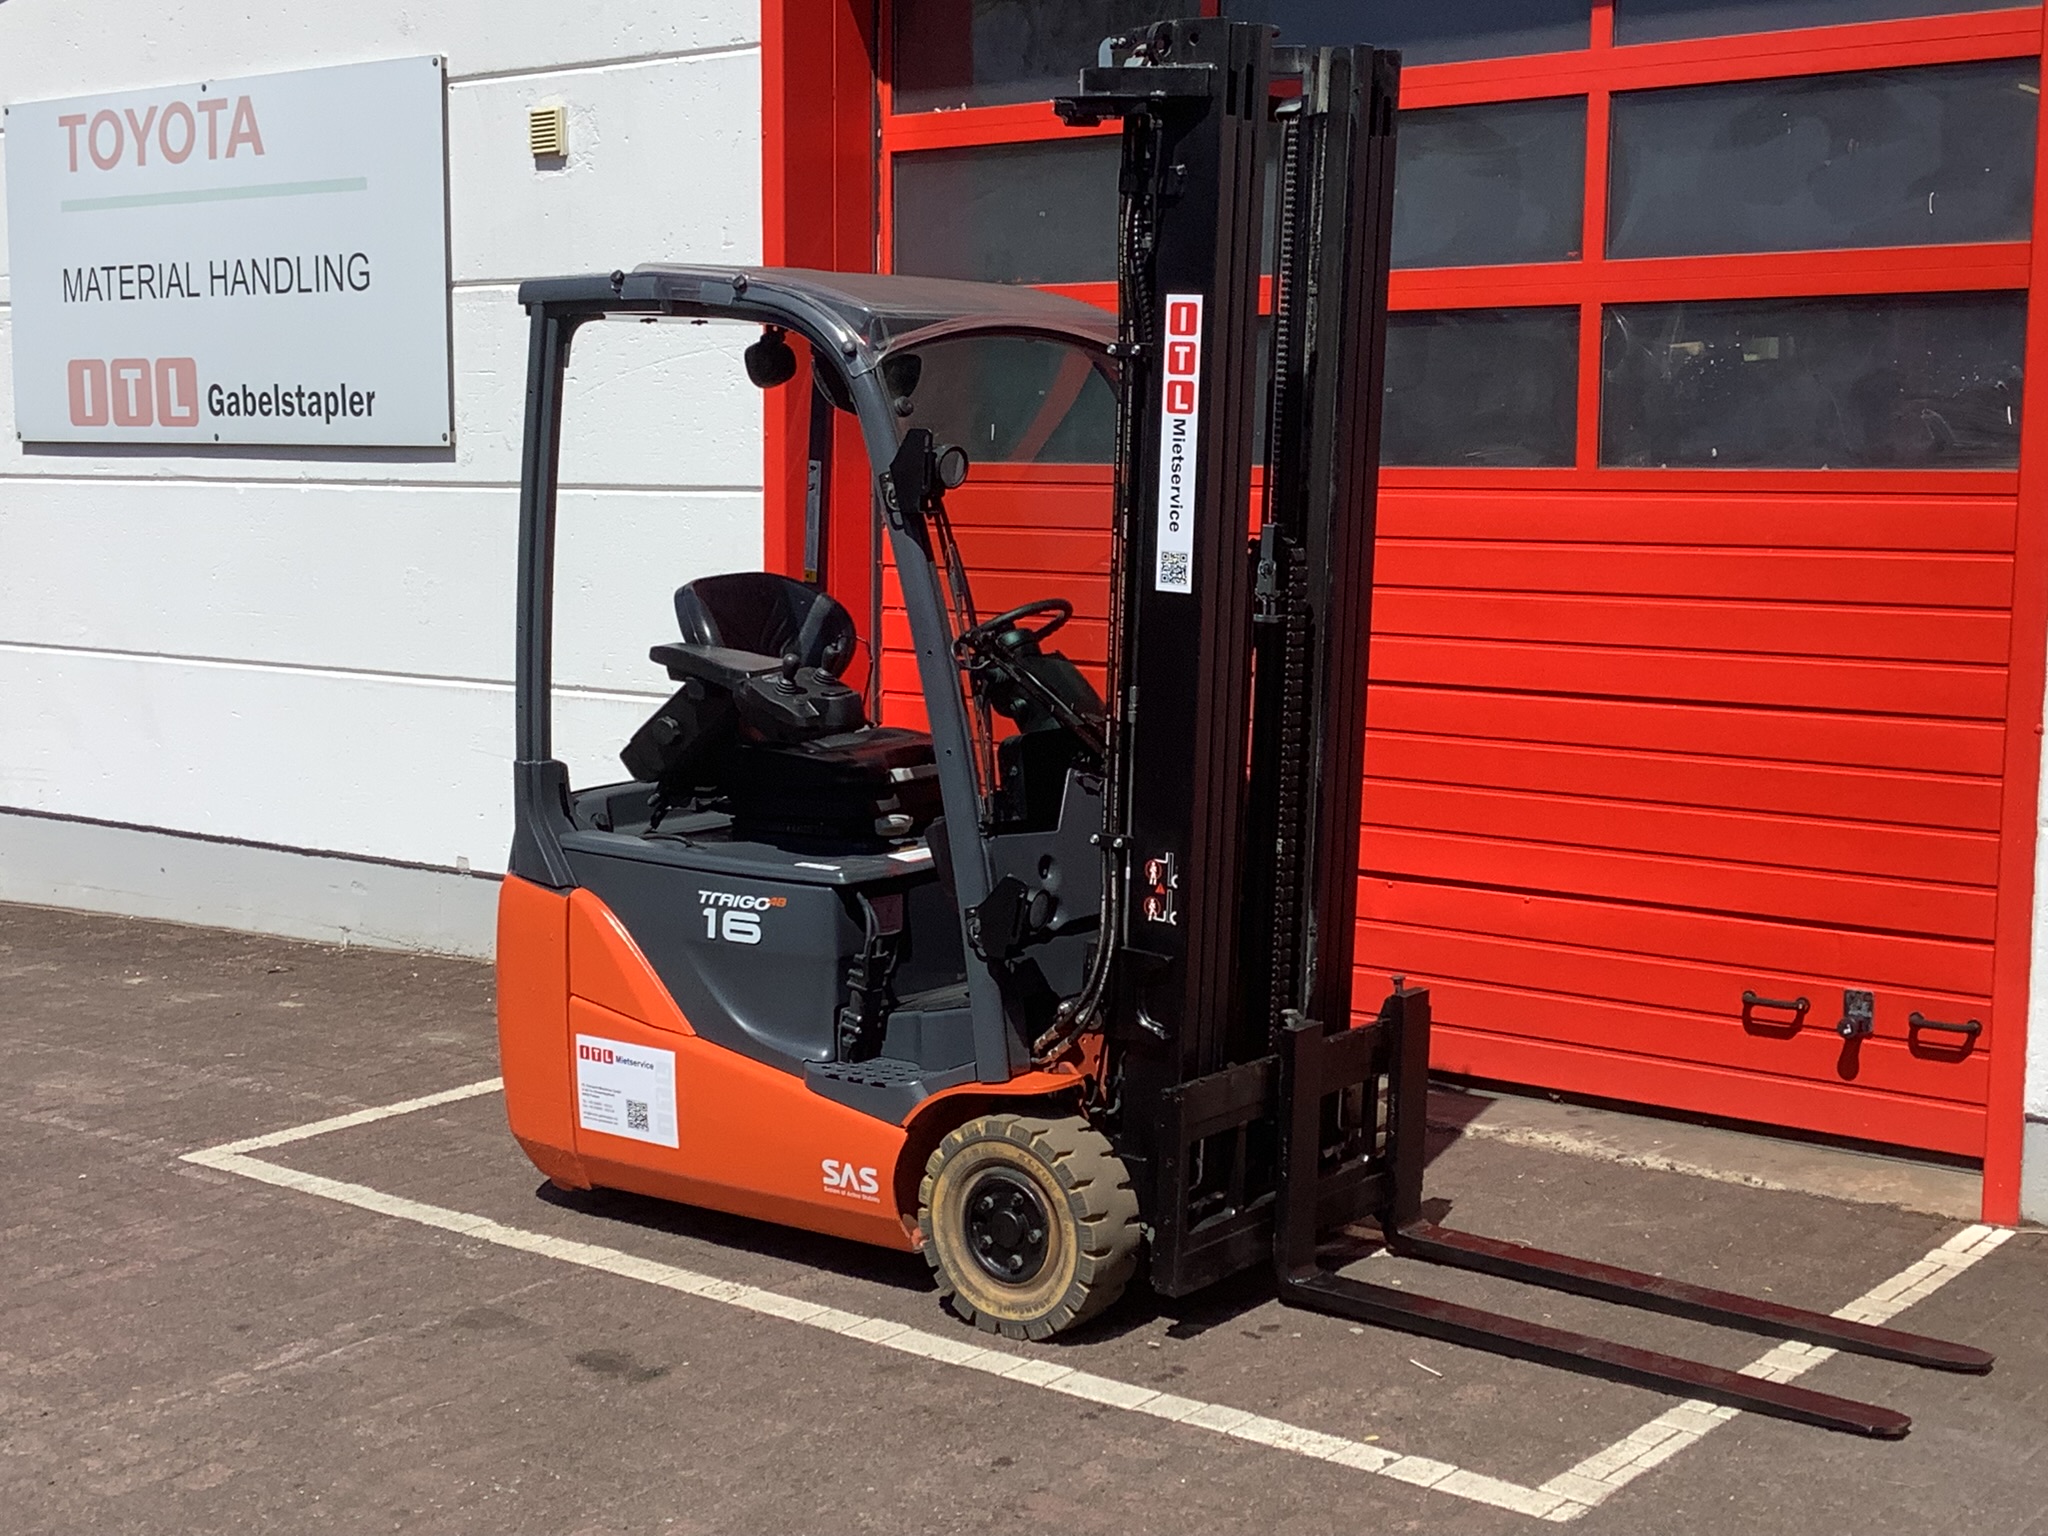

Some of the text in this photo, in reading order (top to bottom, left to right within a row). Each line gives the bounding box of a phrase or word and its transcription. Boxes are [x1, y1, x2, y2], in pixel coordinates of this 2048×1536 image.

[58, 95, 266, 173] TOYOTA
[63, 252, 371, 303] MATERIAL HANDLING
[72, 360, 376, 425] ITL Gabelstapler
[1168, 304, 1195, 533] ITL Mietservice
[702, 907, 762, 945] 16
[580, 1045, 655, 1071] ITL Mietservice
[821, 1158, 879, 1195] SAS
